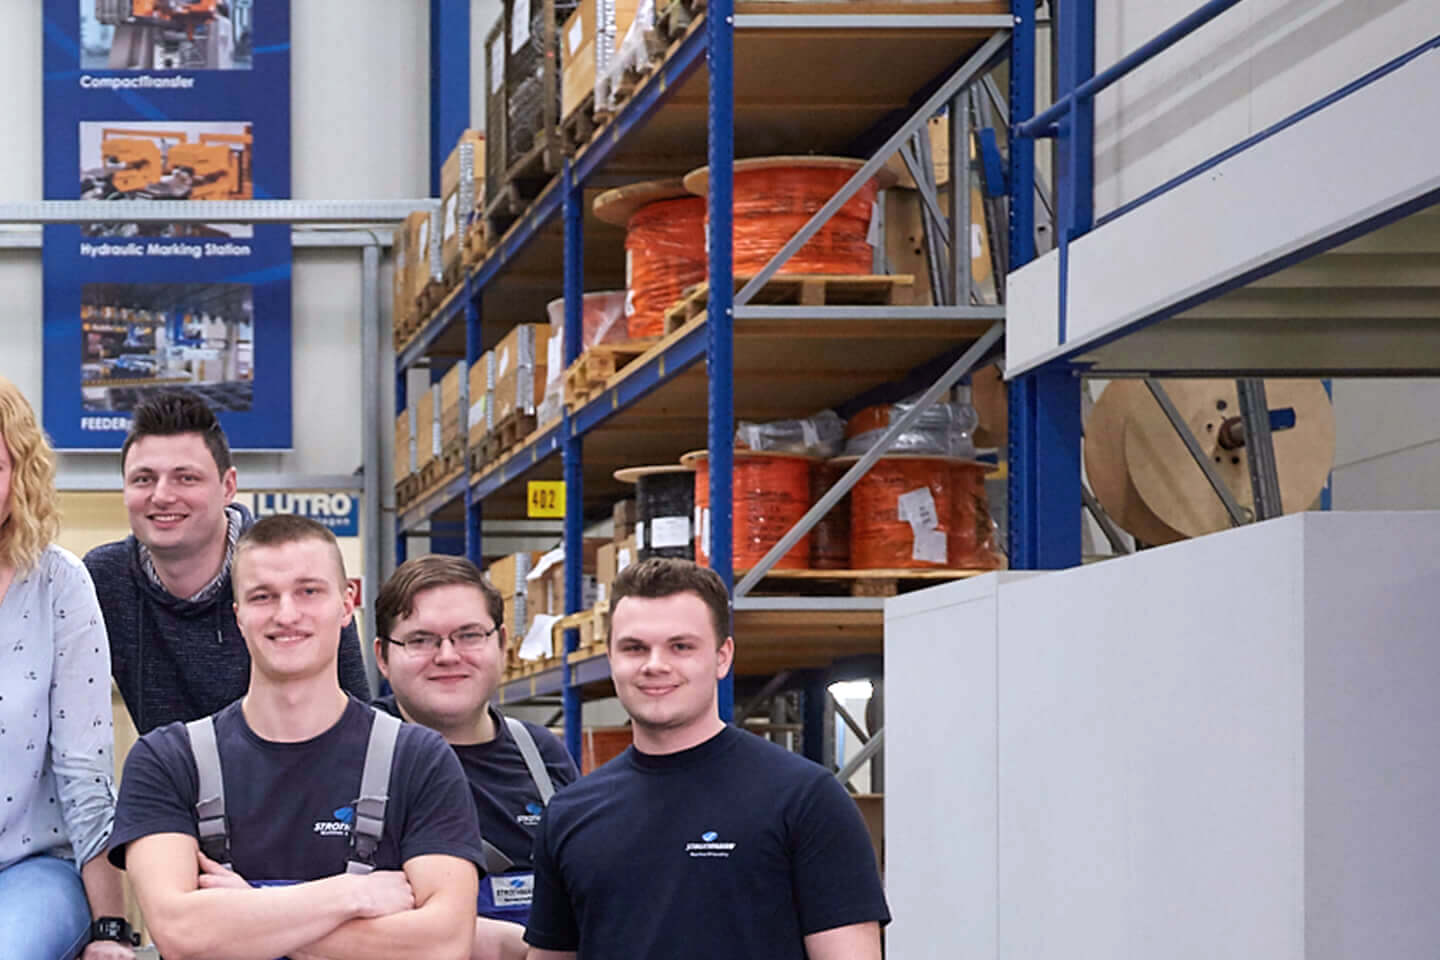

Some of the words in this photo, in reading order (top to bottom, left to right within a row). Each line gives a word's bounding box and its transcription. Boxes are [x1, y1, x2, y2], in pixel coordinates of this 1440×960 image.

[79, 74, 195, 90] CompactTransfer
[80, 242, 144, 258] Hydraulic
[146, 242, 203, 259] Marking
[204, 242, 252, 256] Station
[259, 492, 352, 516] LUTRO
[532, 489, 555, 508] 402
